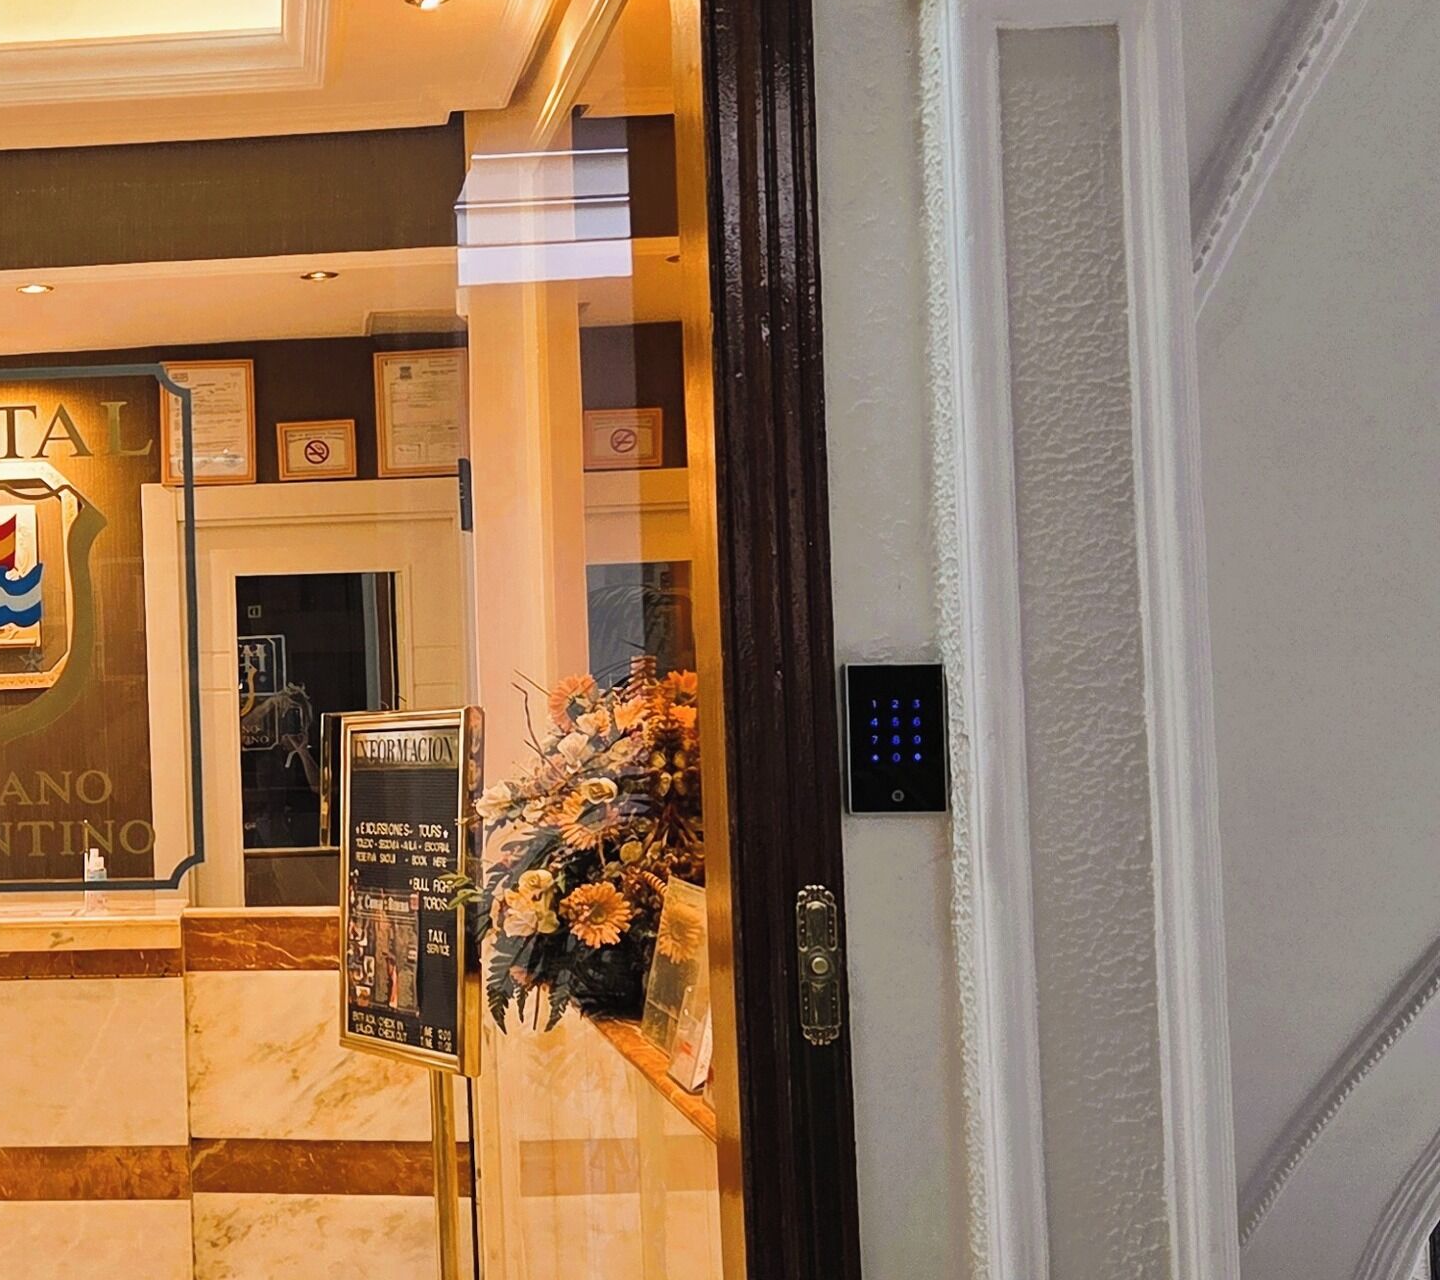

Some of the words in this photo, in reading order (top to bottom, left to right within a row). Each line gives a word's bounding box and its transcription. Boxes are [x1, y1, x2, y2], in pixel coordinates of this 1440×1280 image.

[353, 736, 453, 763] INFORMACION
[419, 824, 442, 838] TOURS
[428, 929, 447, 945] TAXI
